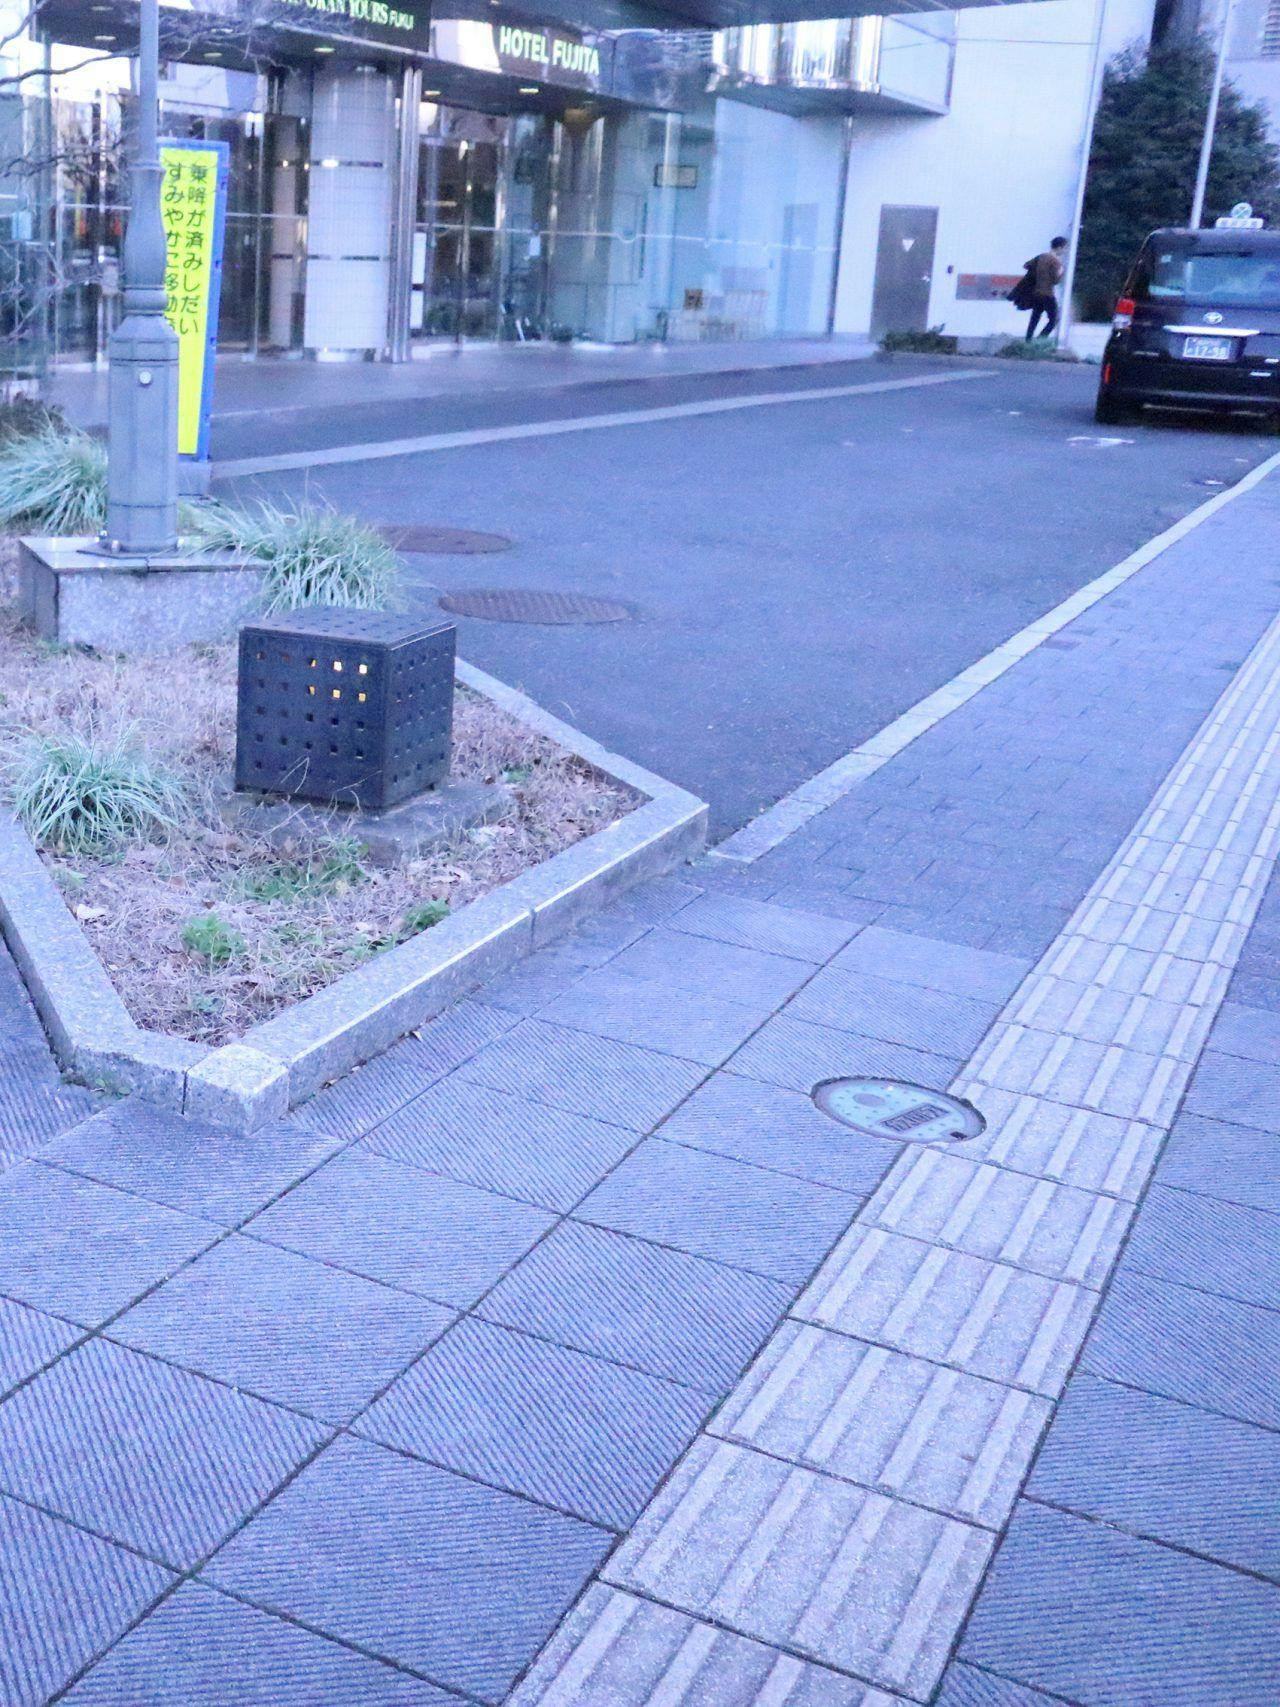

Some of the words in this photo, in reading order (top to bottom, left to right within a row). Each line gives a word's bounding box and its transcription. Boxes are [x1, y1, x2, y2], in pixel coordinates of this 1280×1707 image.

[389, 9, 415, 31] FUKUI
[499, 25, 550, 64] HOTEL
[552, 38, 600, 77] FUJITA
[179, 163, 208, 335] 乗降が済みしだい
